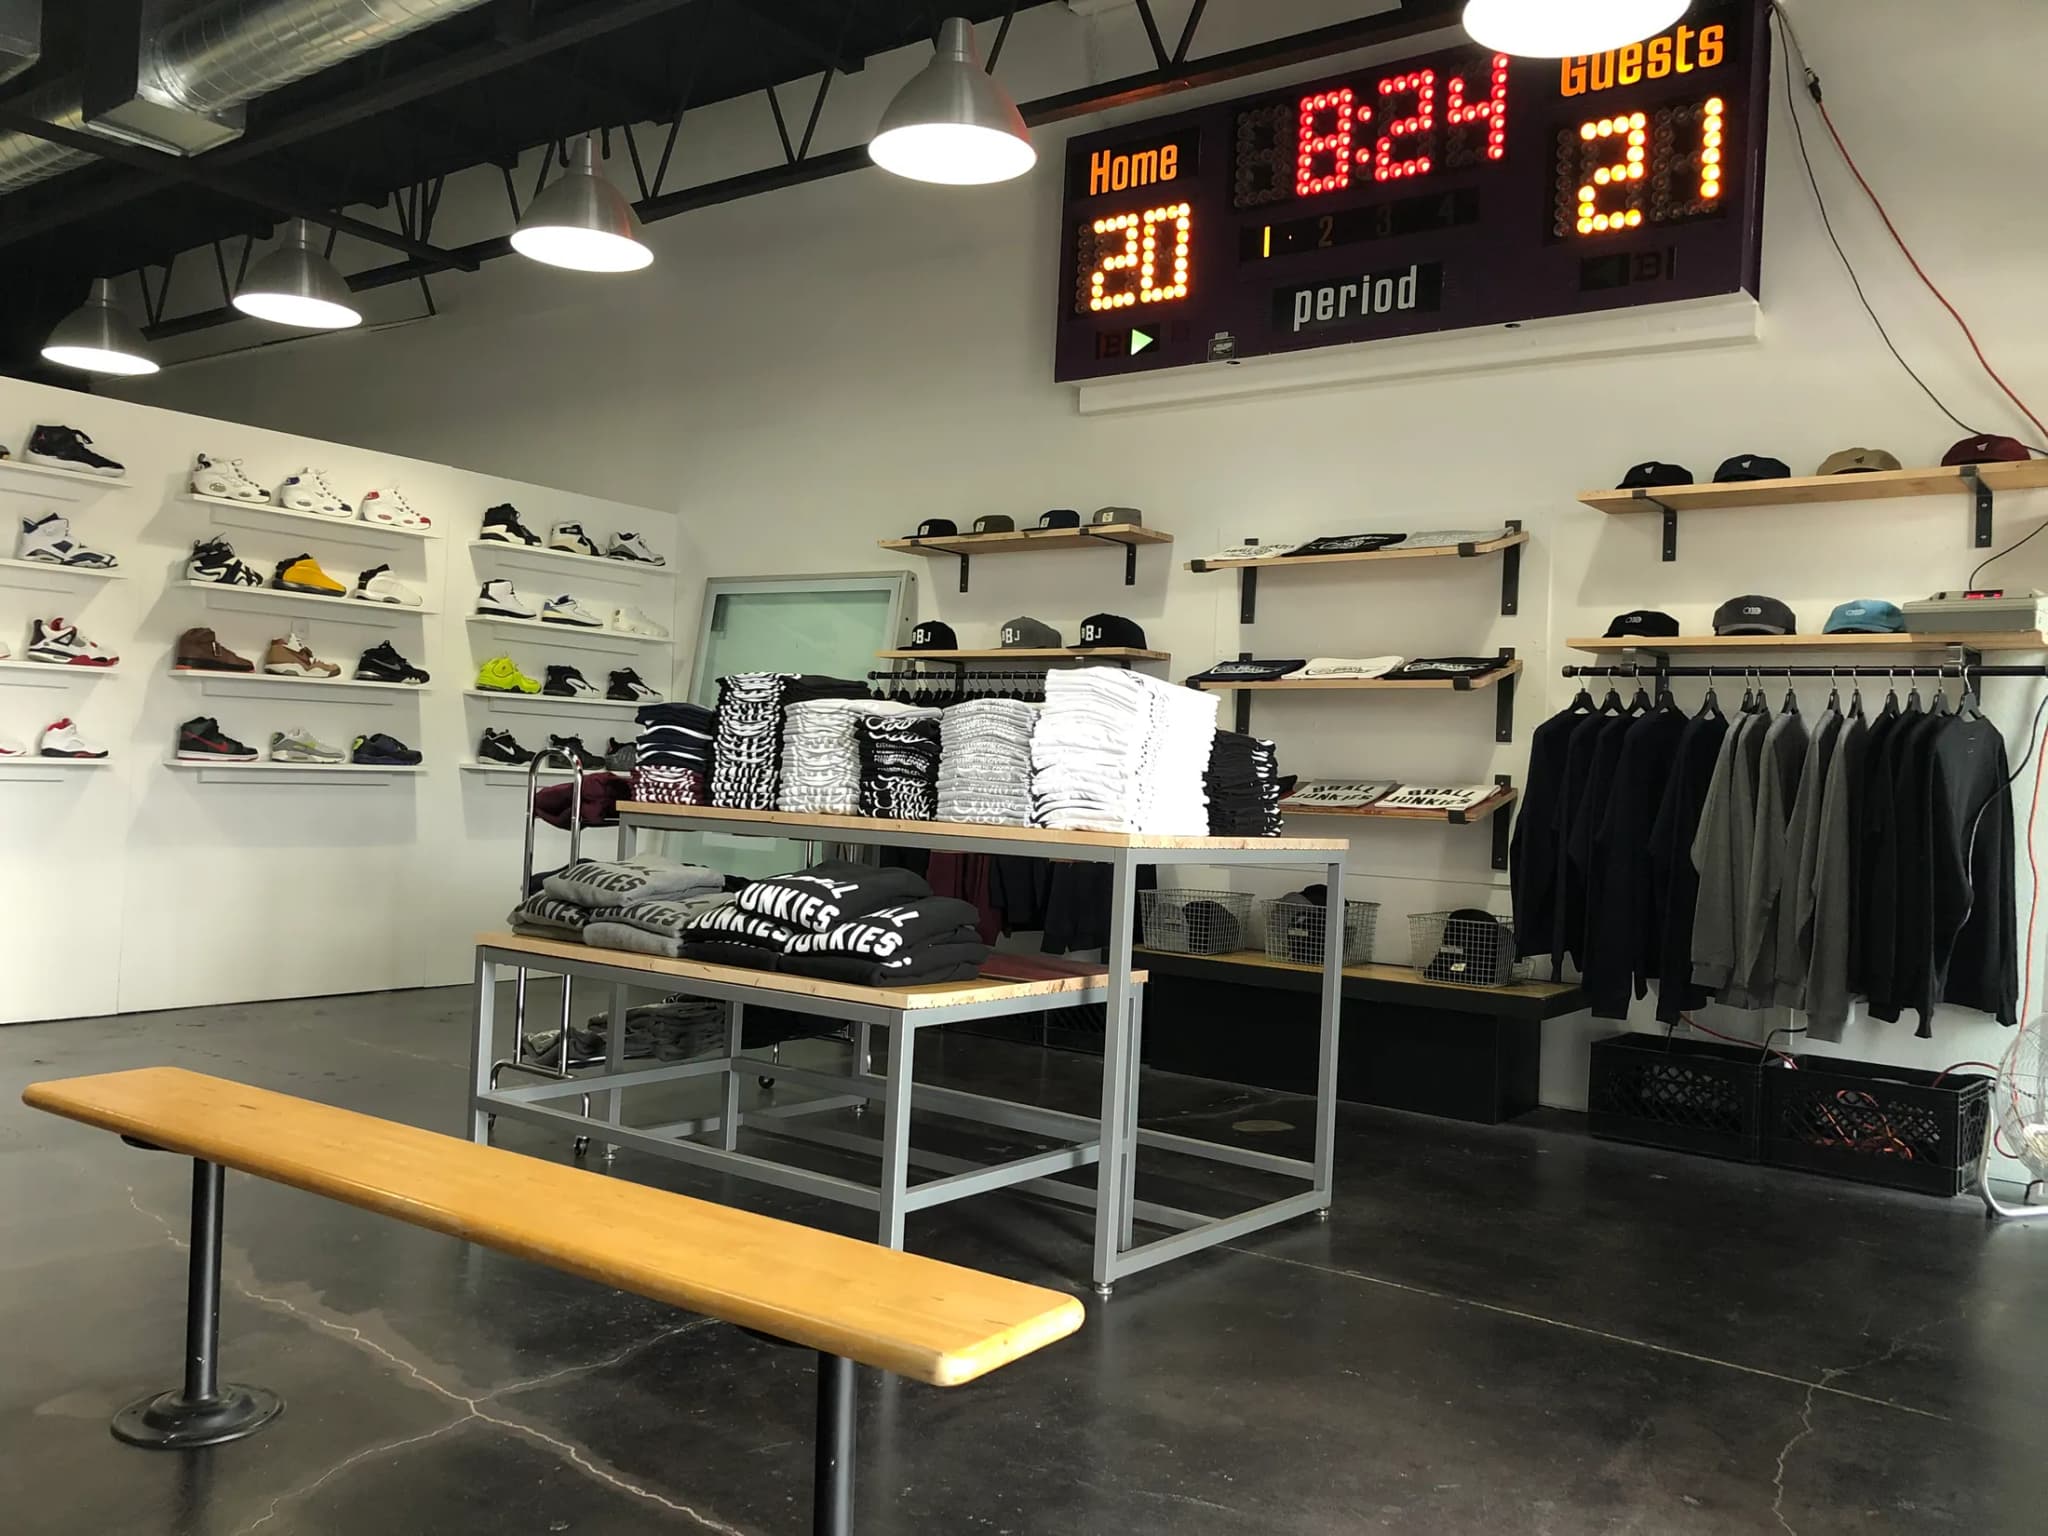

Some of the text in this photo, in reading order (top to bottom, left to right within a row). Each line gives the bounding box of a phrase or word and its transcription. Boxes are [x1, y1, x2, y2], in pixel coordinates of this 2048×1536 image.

[1560, 25, 1724, 97] Guests
[1296, 51, 1510, 197] 8:24
[1089, 144, 1178, 196] Home
[1576, 96, 1724, 235] 21
[1089, 202, 1191, 312] 20
[1317, 215, 1335, 249] 2
[1375, 205, 1393, 237] 3
[1293, 264, 1418, 333] period
